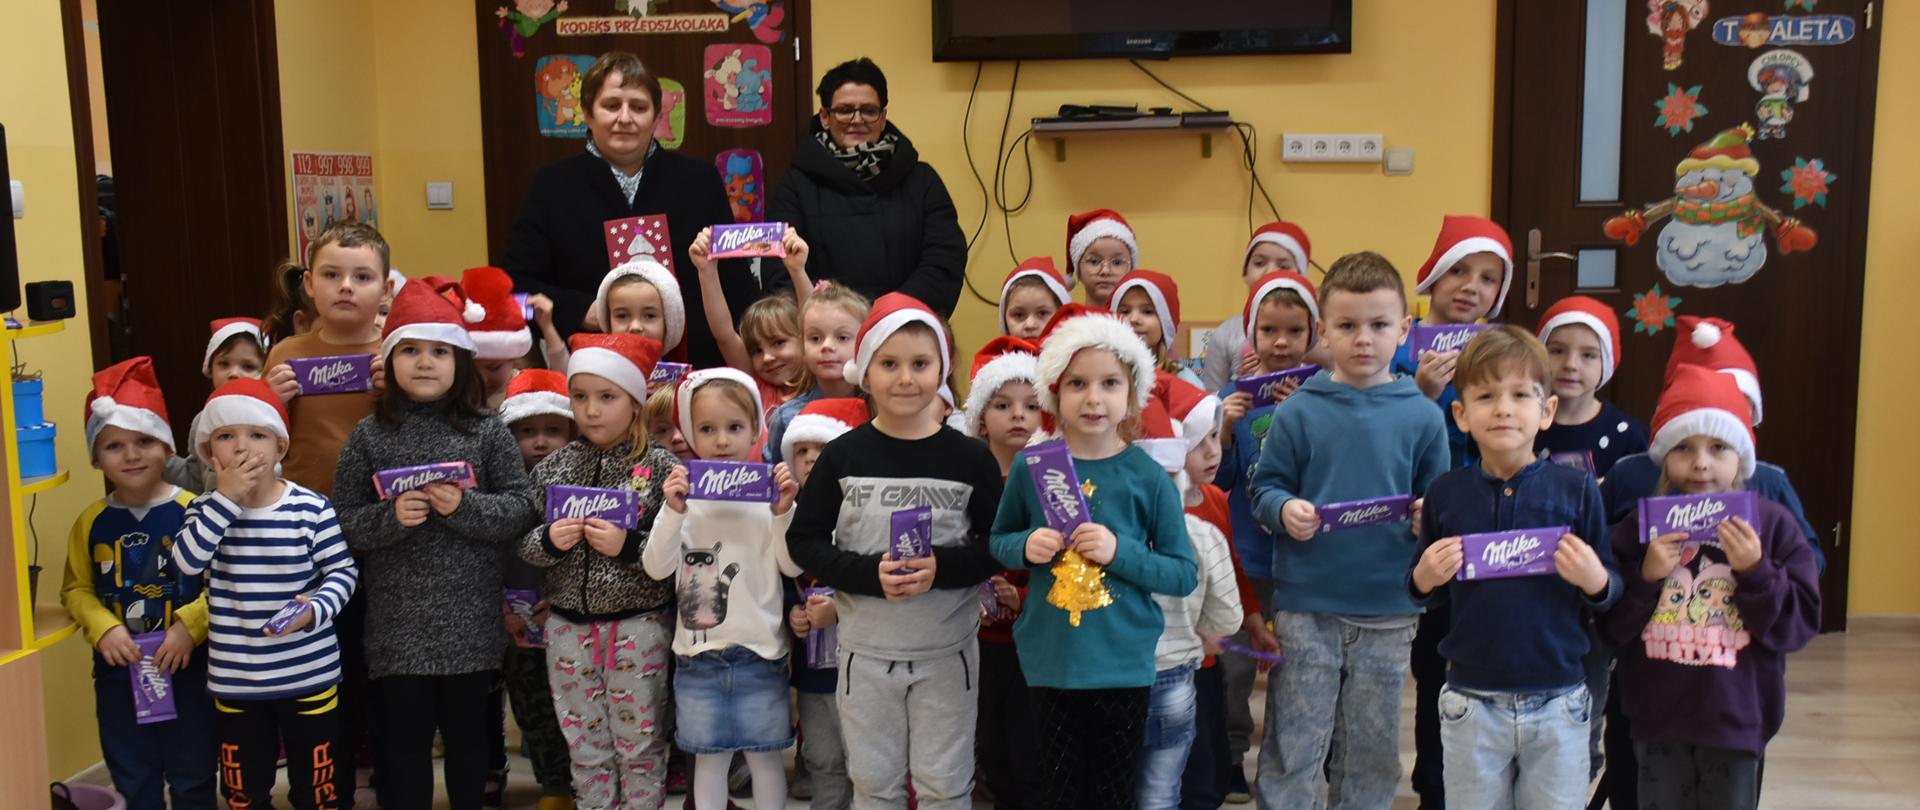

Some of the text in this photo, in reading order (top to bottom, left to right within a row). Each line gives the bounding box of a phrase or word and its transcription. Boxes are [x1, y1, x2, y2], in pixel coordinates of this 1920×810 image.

[560, 18, 726, 34] KODEKS PRZEDSZKOLAKA
[1722, 20, 1845, 41] TALETA
[297, 155, 370, 175] 112 997 998 999
[718, 225, 764, 250] Milka
[308, 360, 355, 385] Milka
[392, 470, 446, 493] Milka
[698, 465, 762, 495] Milka
[562, 493, 621, 518] Milka
[1043, 468, 1080, 519] Milka
[1338, 504, 1391, 524] Milka
[1666, 497, 1726, 529] Milka
[1482, 534, 1541, 566] Milka
[140, 655, 168, 699] Milka
